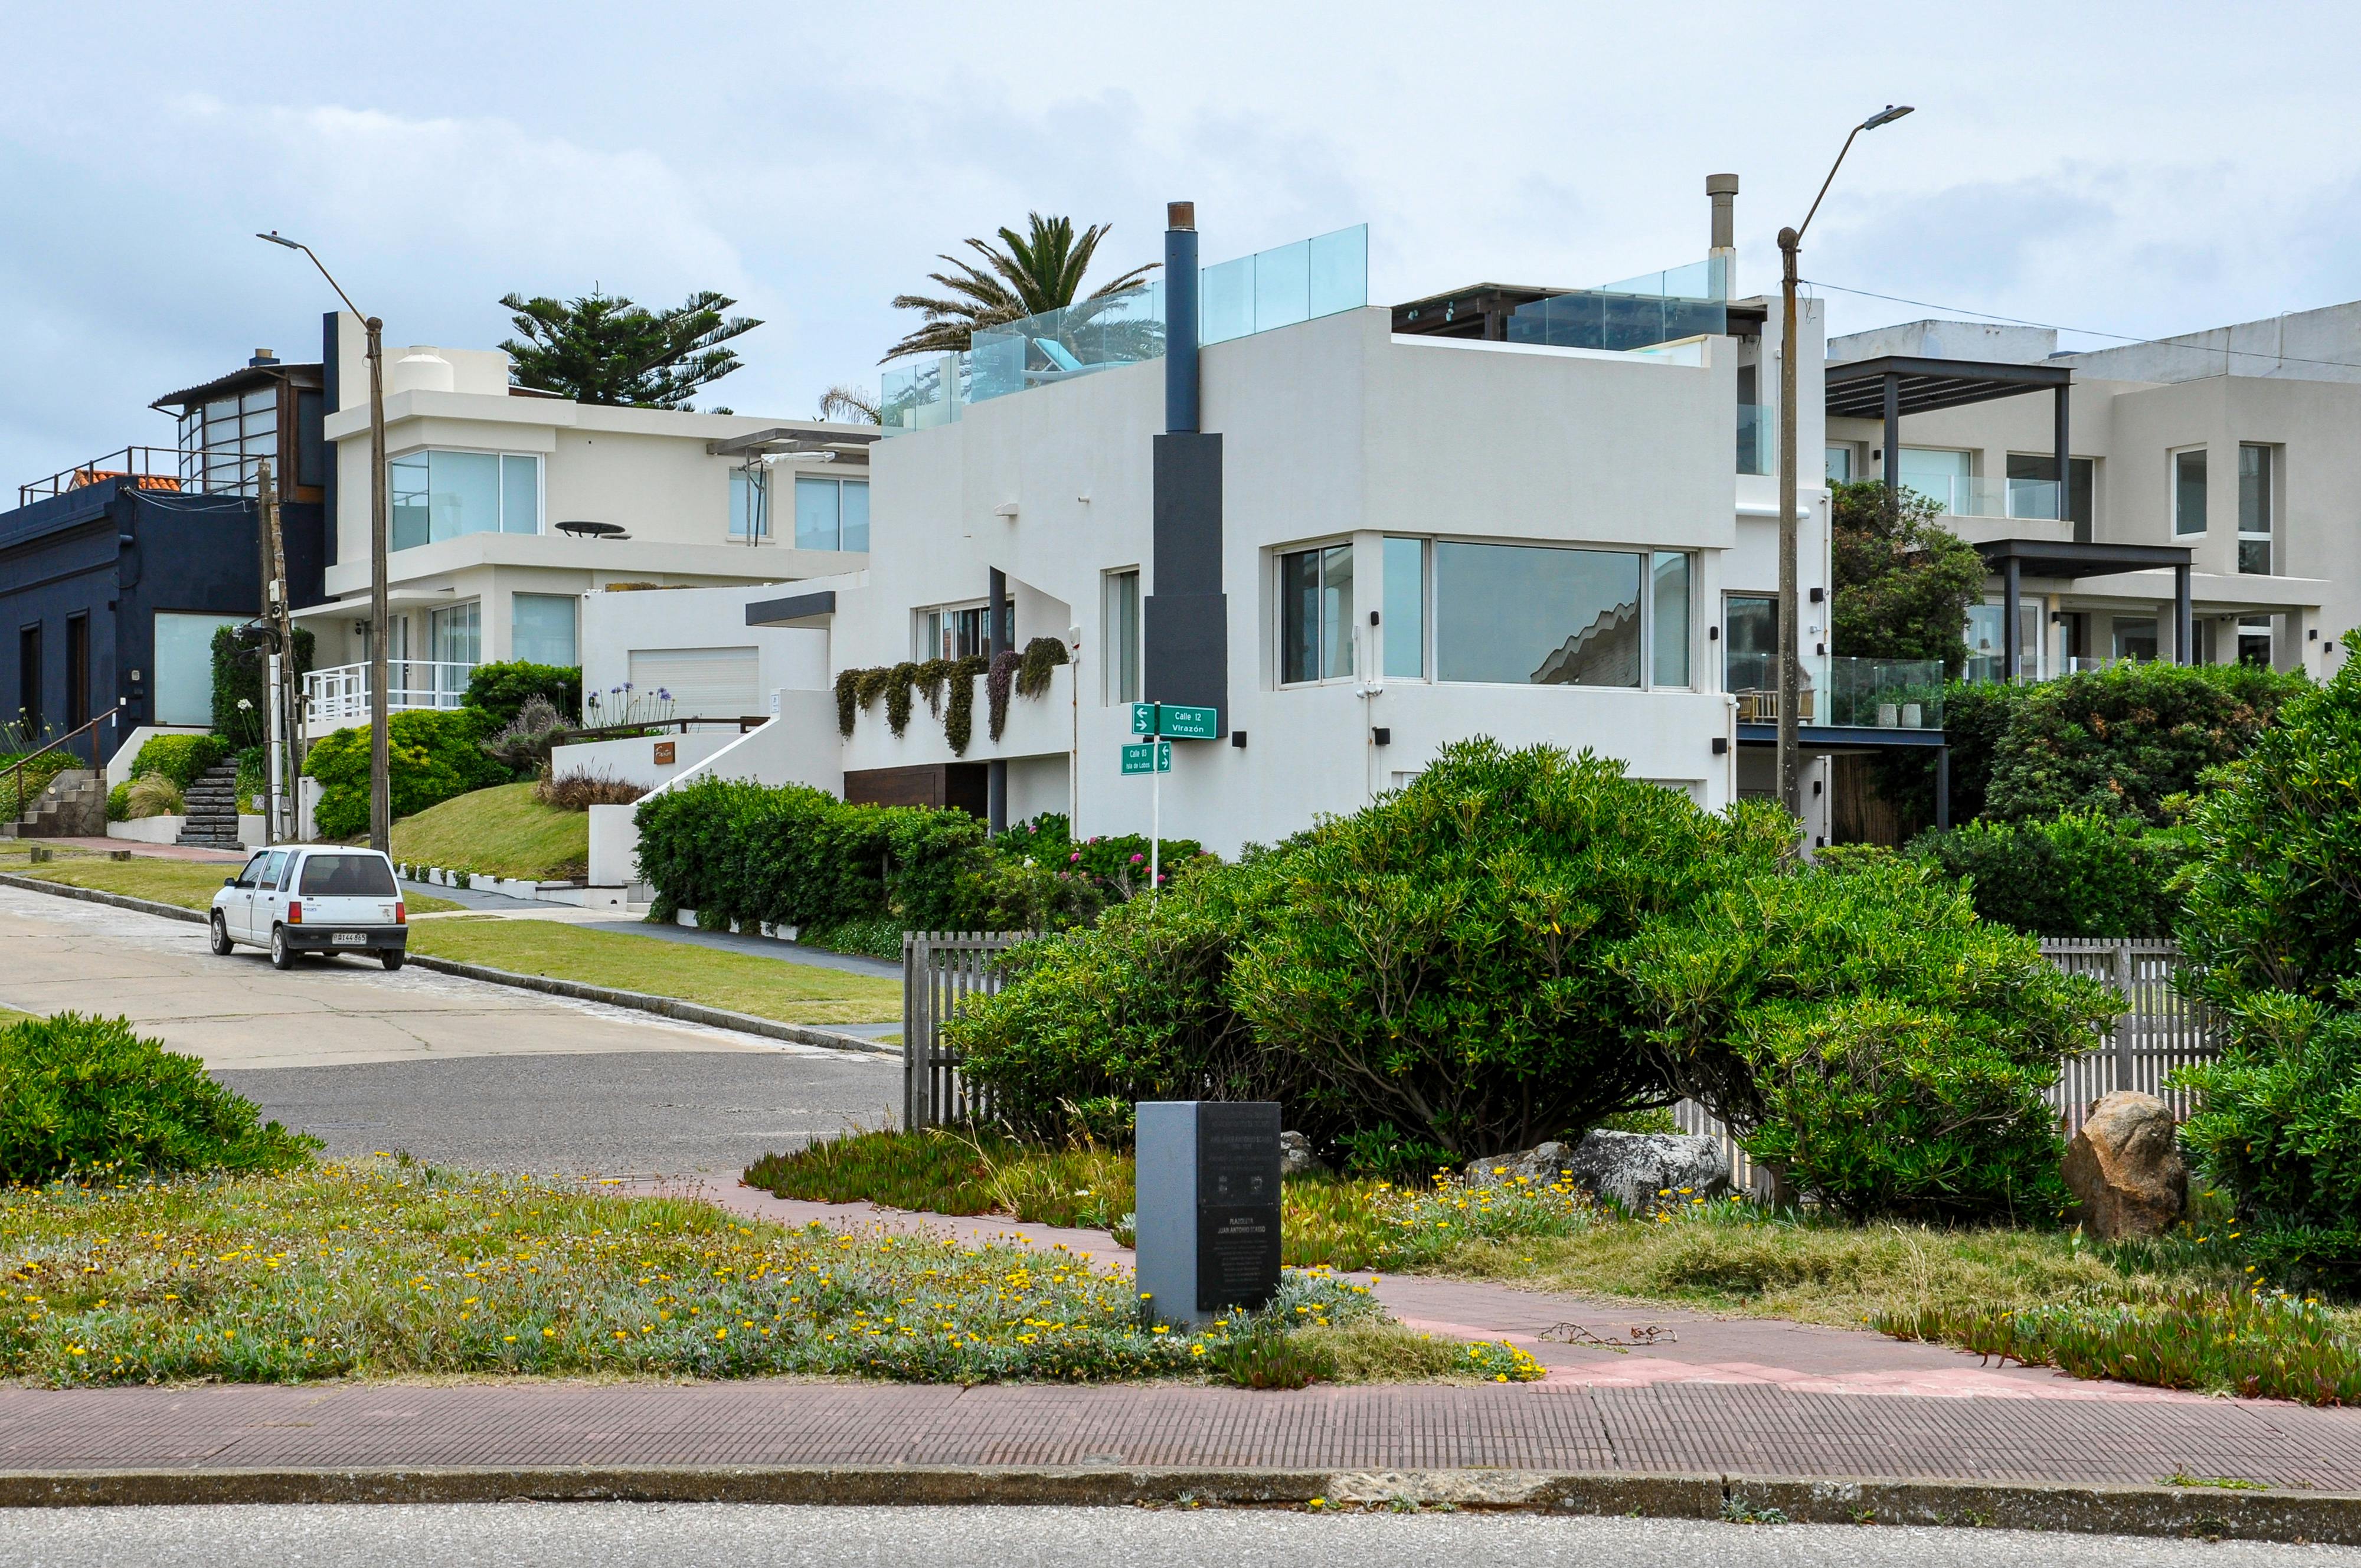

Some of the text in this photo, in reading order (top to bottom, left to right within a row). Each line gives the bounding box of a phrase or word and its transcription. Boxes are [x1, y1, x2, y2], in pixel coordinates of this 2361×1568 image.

[1175, 712, 1202, 721] Calle 12
[1172, 724, 1204, 733] Virazón
[1130, 749, 1147, 758] Calle 03
